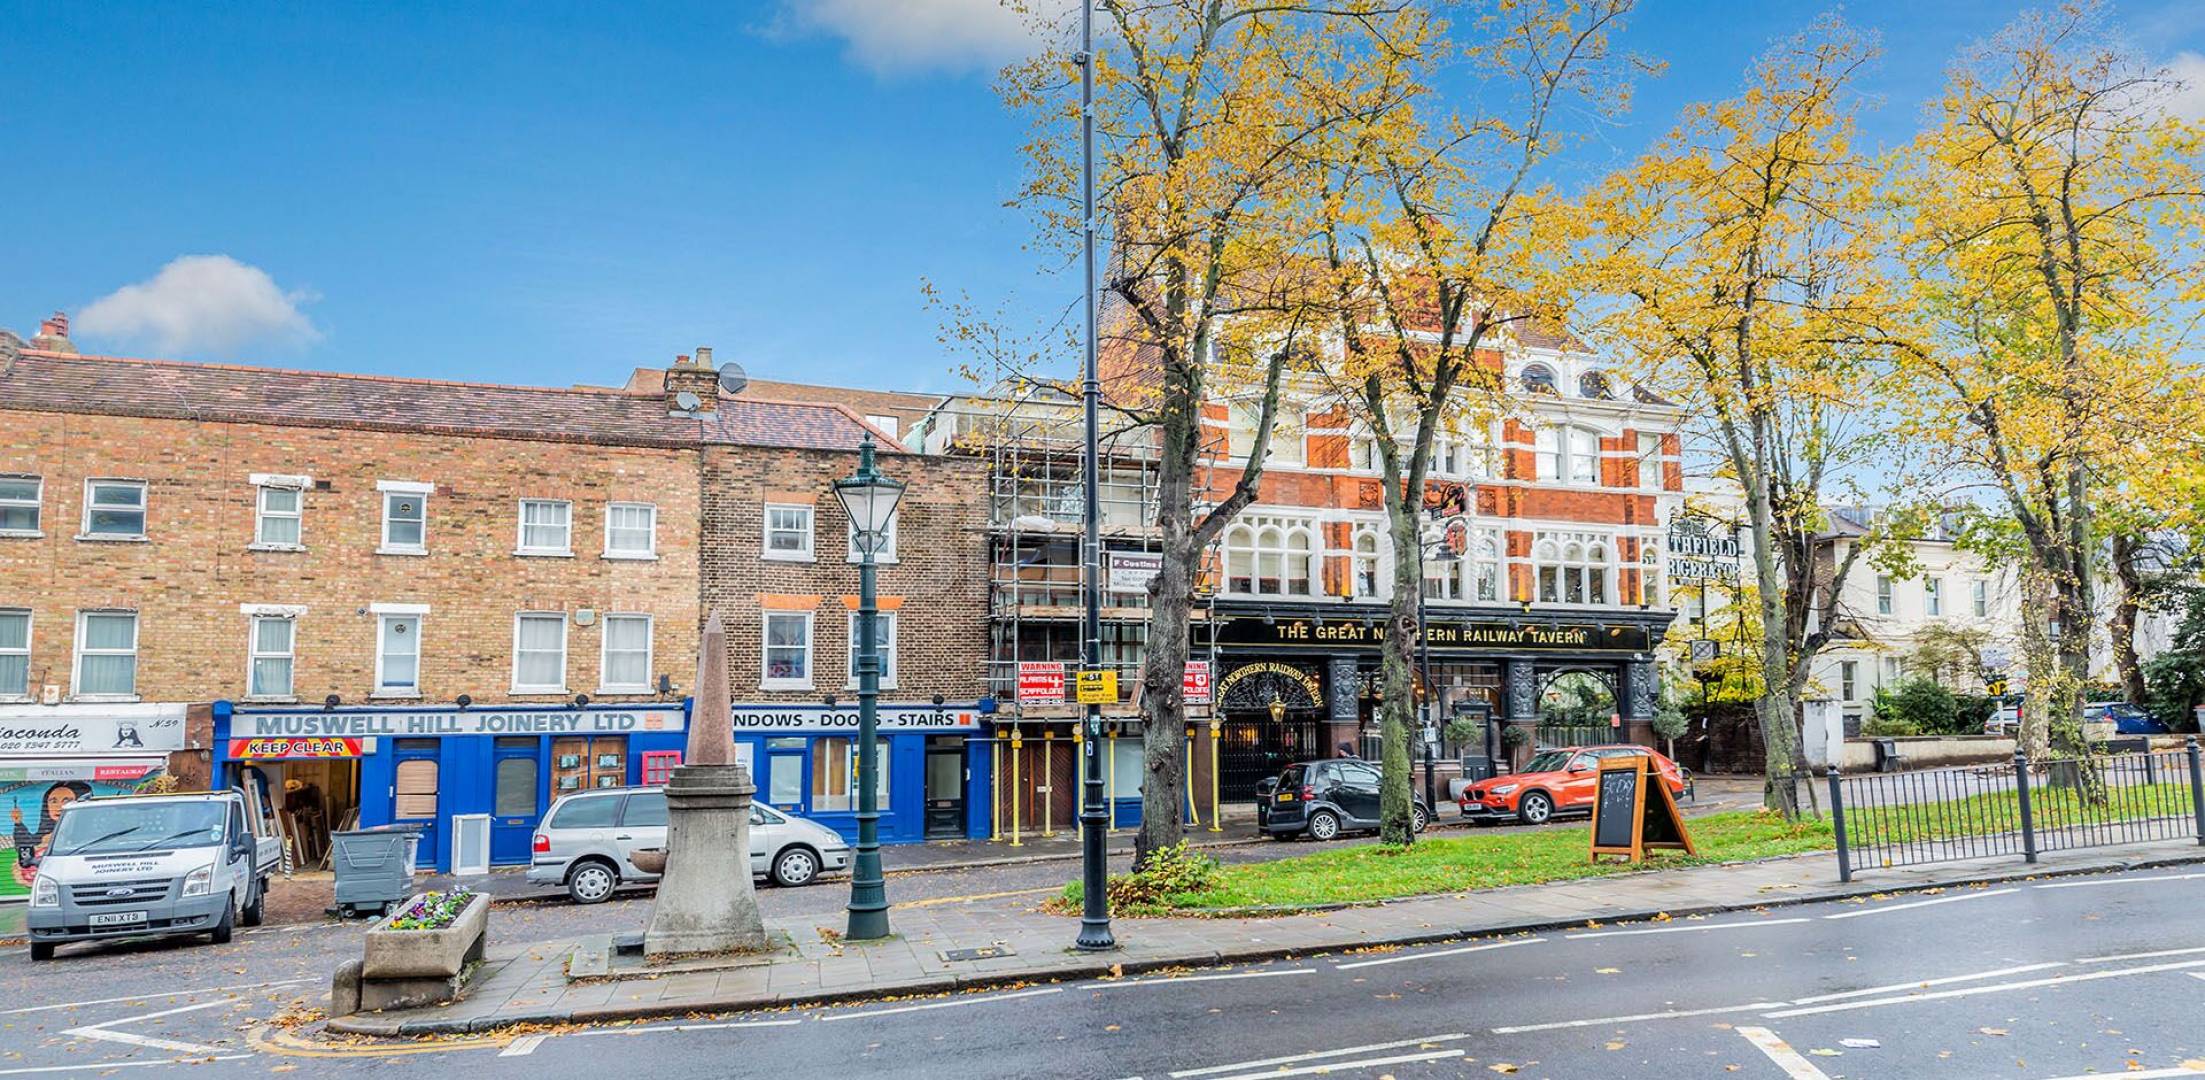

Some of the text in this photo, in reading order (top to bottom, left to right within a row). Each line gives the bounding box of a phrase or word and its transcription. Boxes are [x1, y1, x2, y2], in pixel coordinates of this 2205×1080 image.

[1277, 626, 1584, 644] THE GREAT NHERN RAILWAY TAVERN
[1021, 663, 1062, 671] WARNING
[1224, 662, 1267, 685] NORTHERN
[1268, 662, 1305, 681] RAILWAY
[256, 713, 636, 735] MUSWELL HILL JOINERY LTD
[820, 713, 881, 727] DOOS
[898, 713, 954, 726] STAIRS
[250, 741, 344, 754] KEEP CLEAR
[92, 861, 136, 869] MUSWELL
